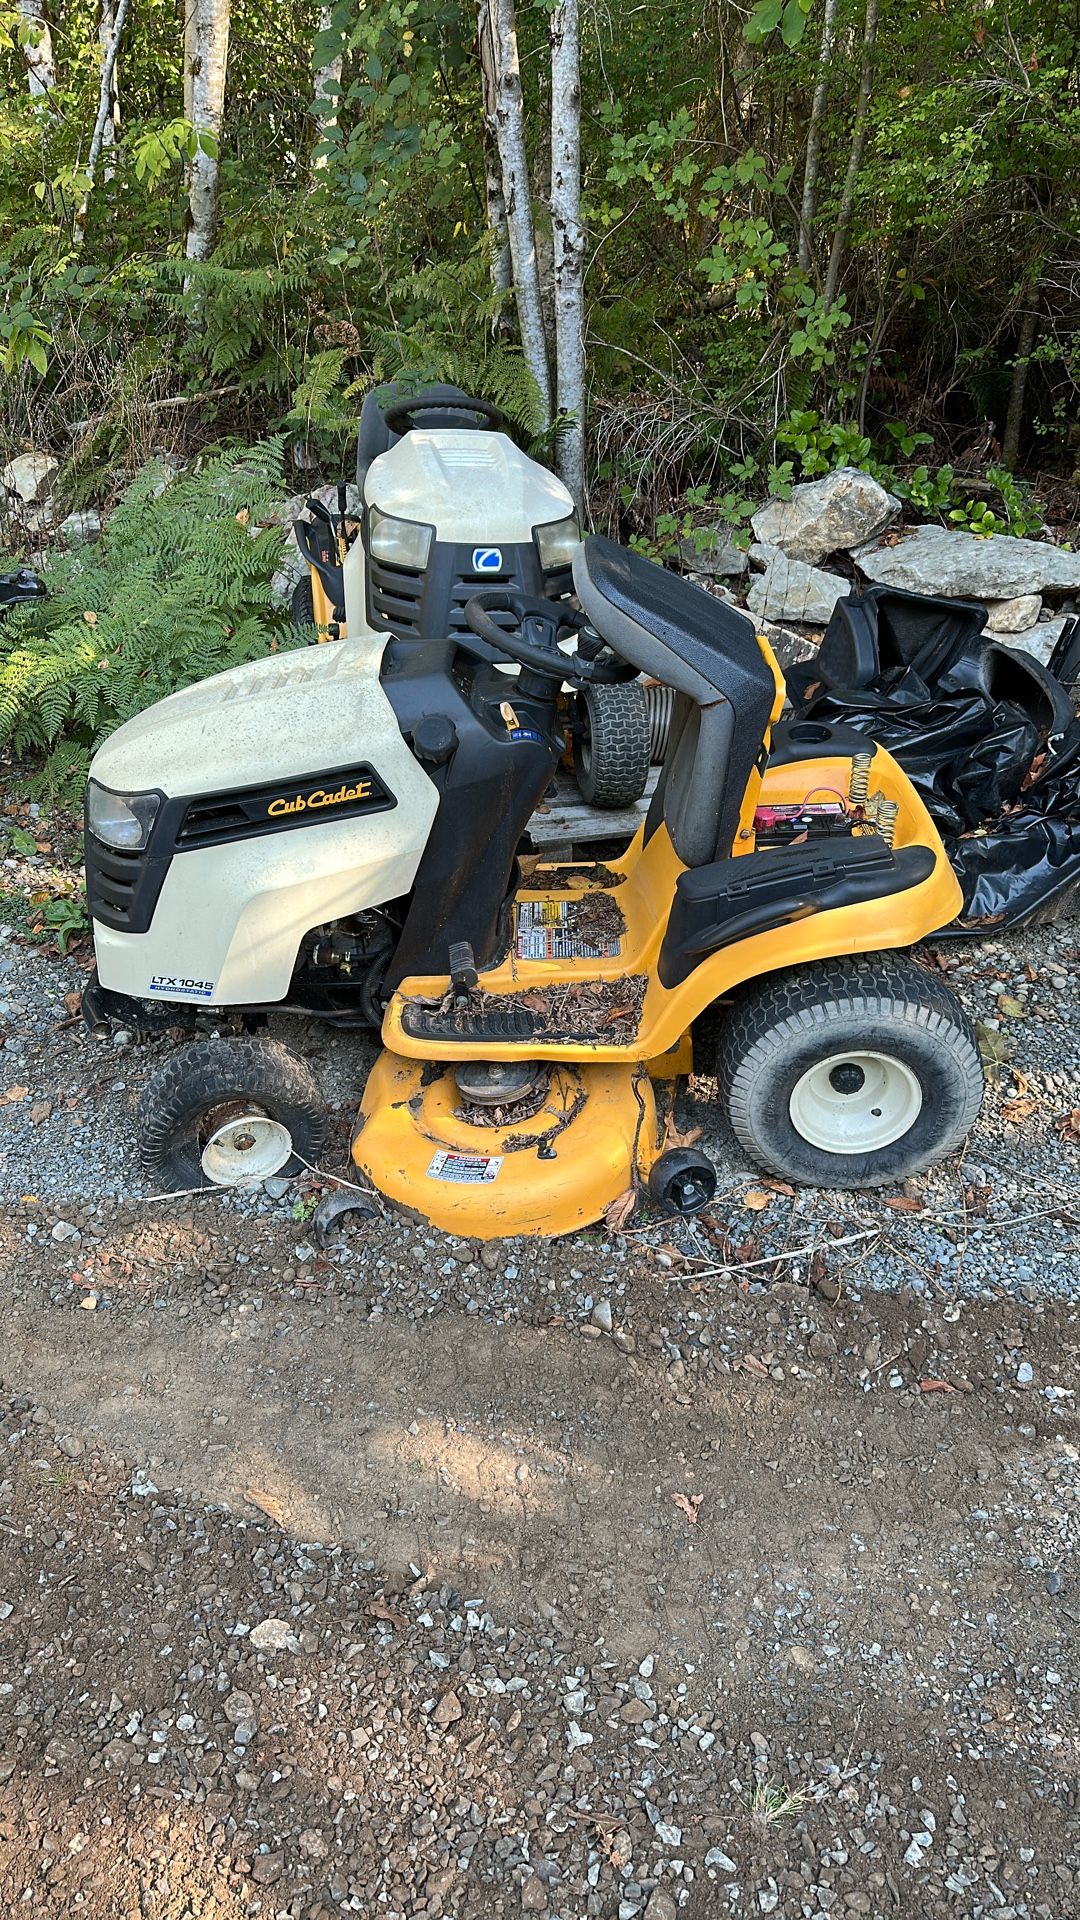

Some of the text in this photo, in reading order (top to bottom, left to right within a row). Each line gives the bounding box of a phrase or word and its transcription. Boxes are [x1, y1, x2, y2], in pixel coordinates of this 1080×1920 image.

[267, 781, 372, 816] Cub Cadet
[151, 976, 215, 990] LTX 1045
